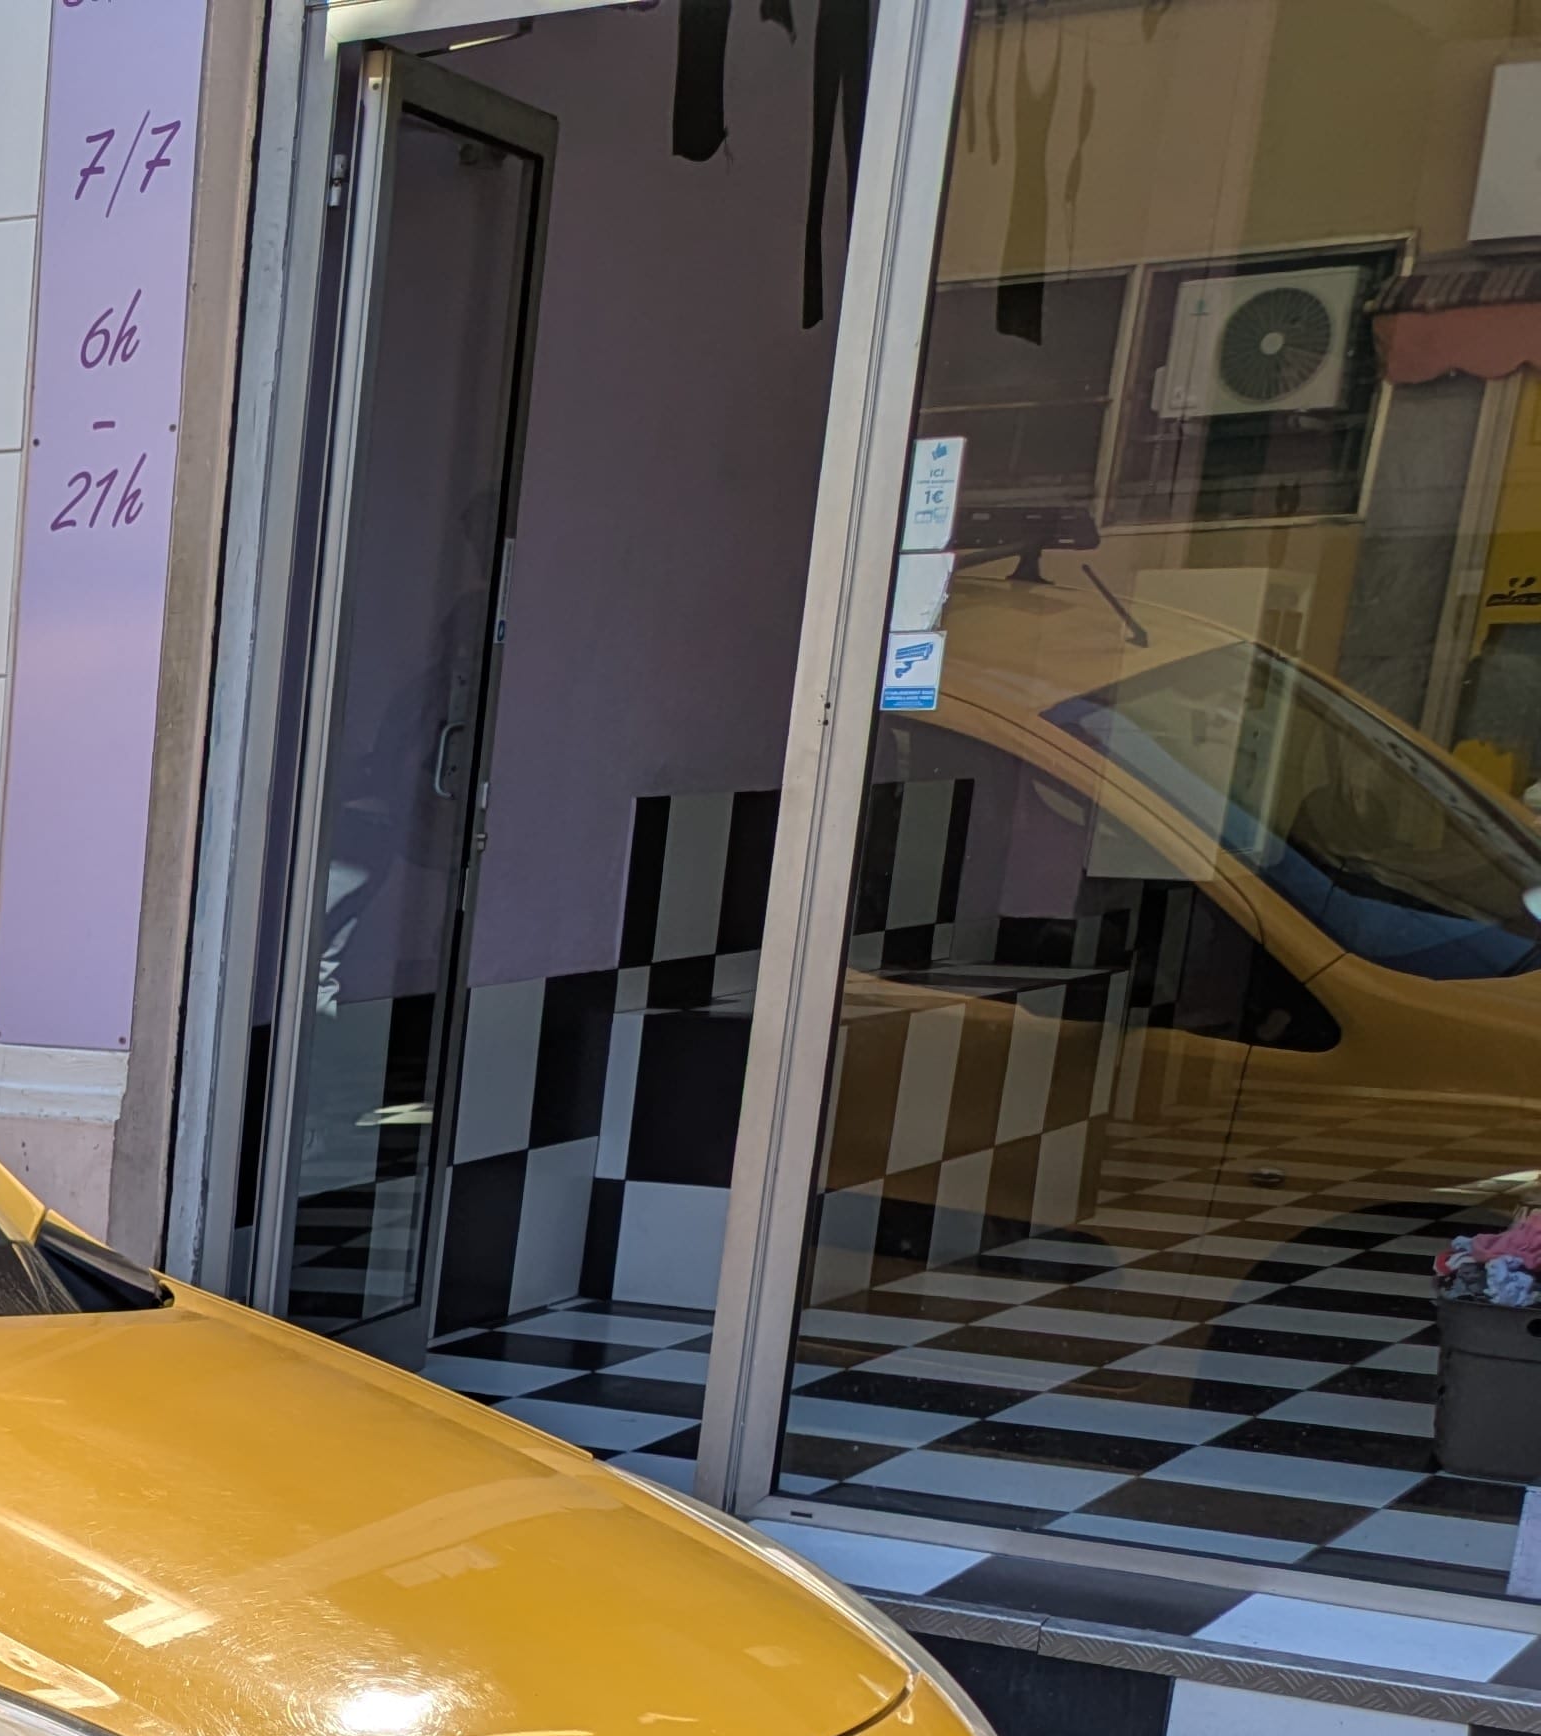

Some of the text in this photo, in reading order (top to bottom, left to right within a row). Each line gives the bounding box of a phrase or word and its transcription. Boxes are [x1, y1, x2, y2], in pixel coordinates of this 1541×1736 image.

[74, 110, 181, 218] 7/7
[79, 289, 142, 369] 6h
[50, 452, 148, 532] 21h
[924, 489, 944, 505] 1€
